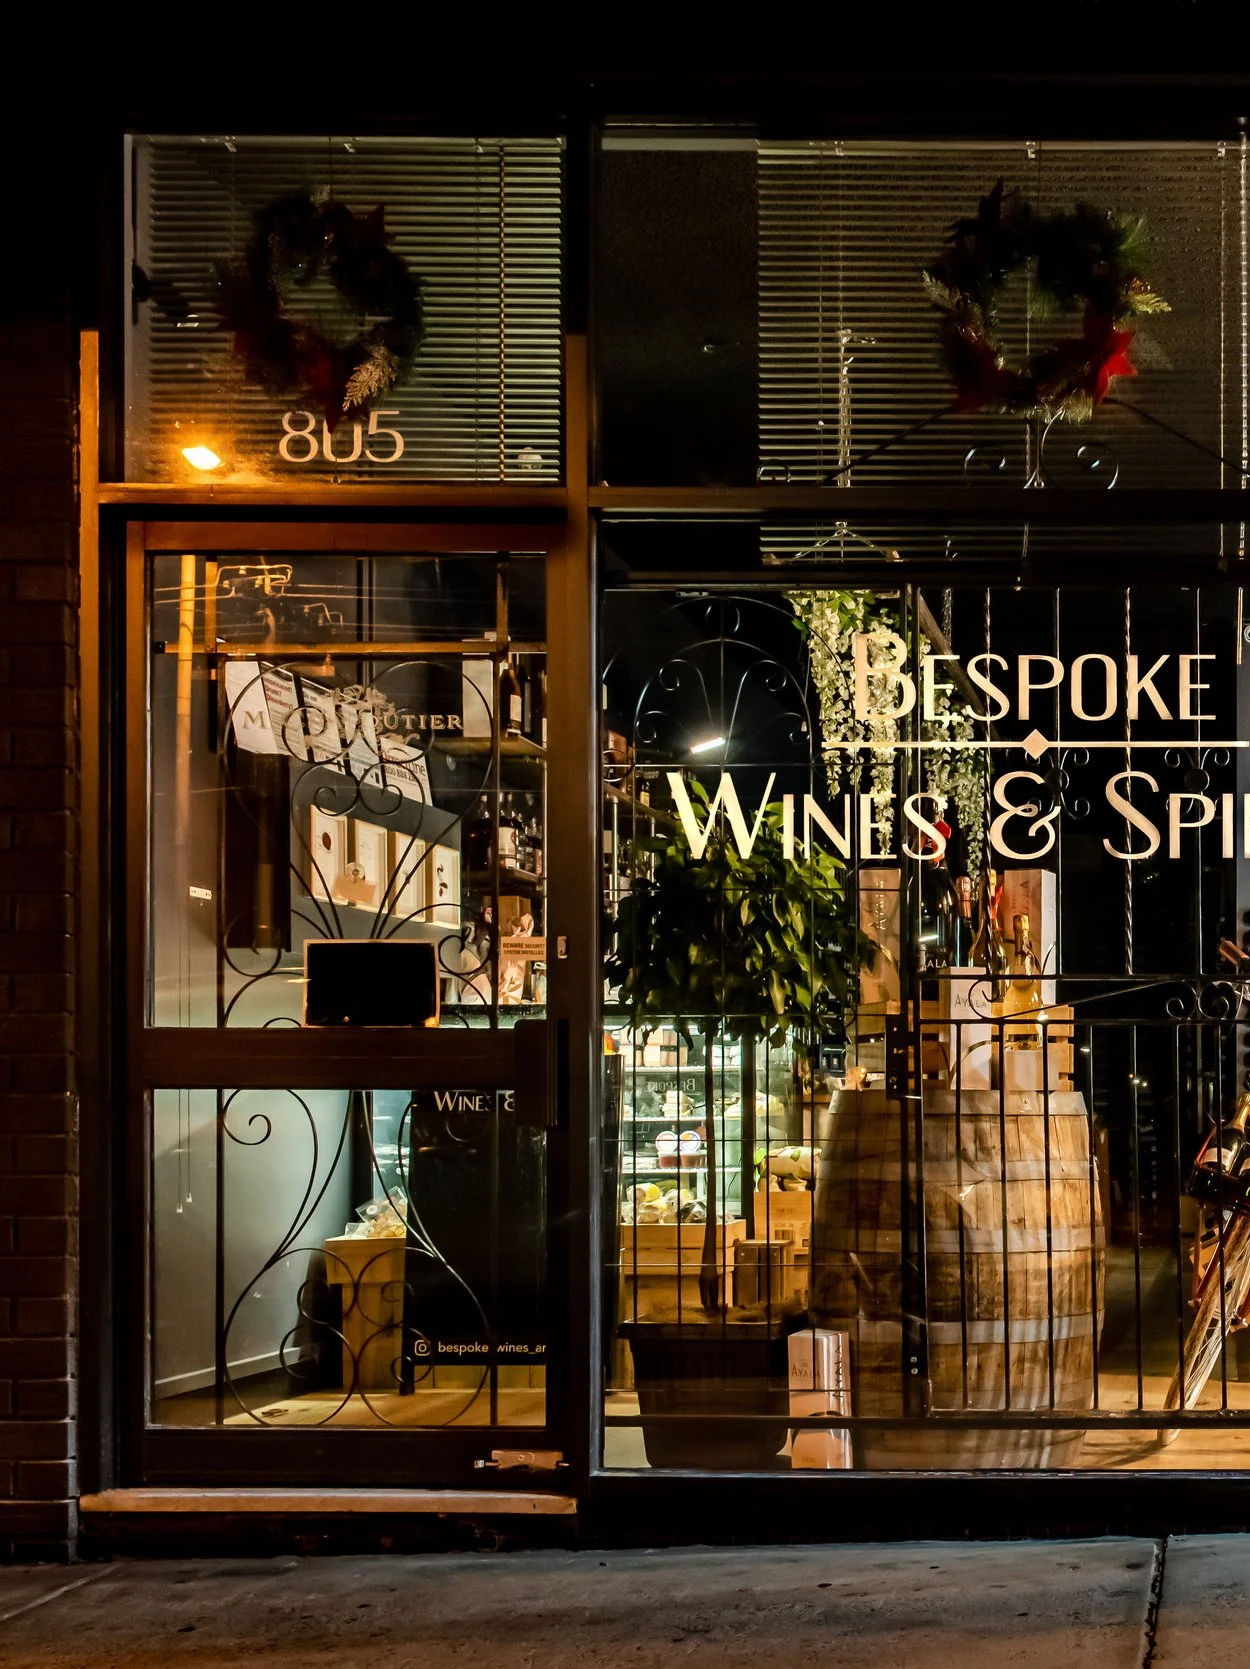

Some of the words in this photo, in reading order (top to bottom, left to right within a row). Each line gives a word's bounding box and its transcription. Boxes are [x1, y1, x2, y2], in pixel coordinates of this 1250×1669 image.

[278, 410, 405, 463] 805
[854, 632, 1217, 722] BESPOKE
[668, 771, 947, 861] WINES
[990, 770, 1062, 861] &
